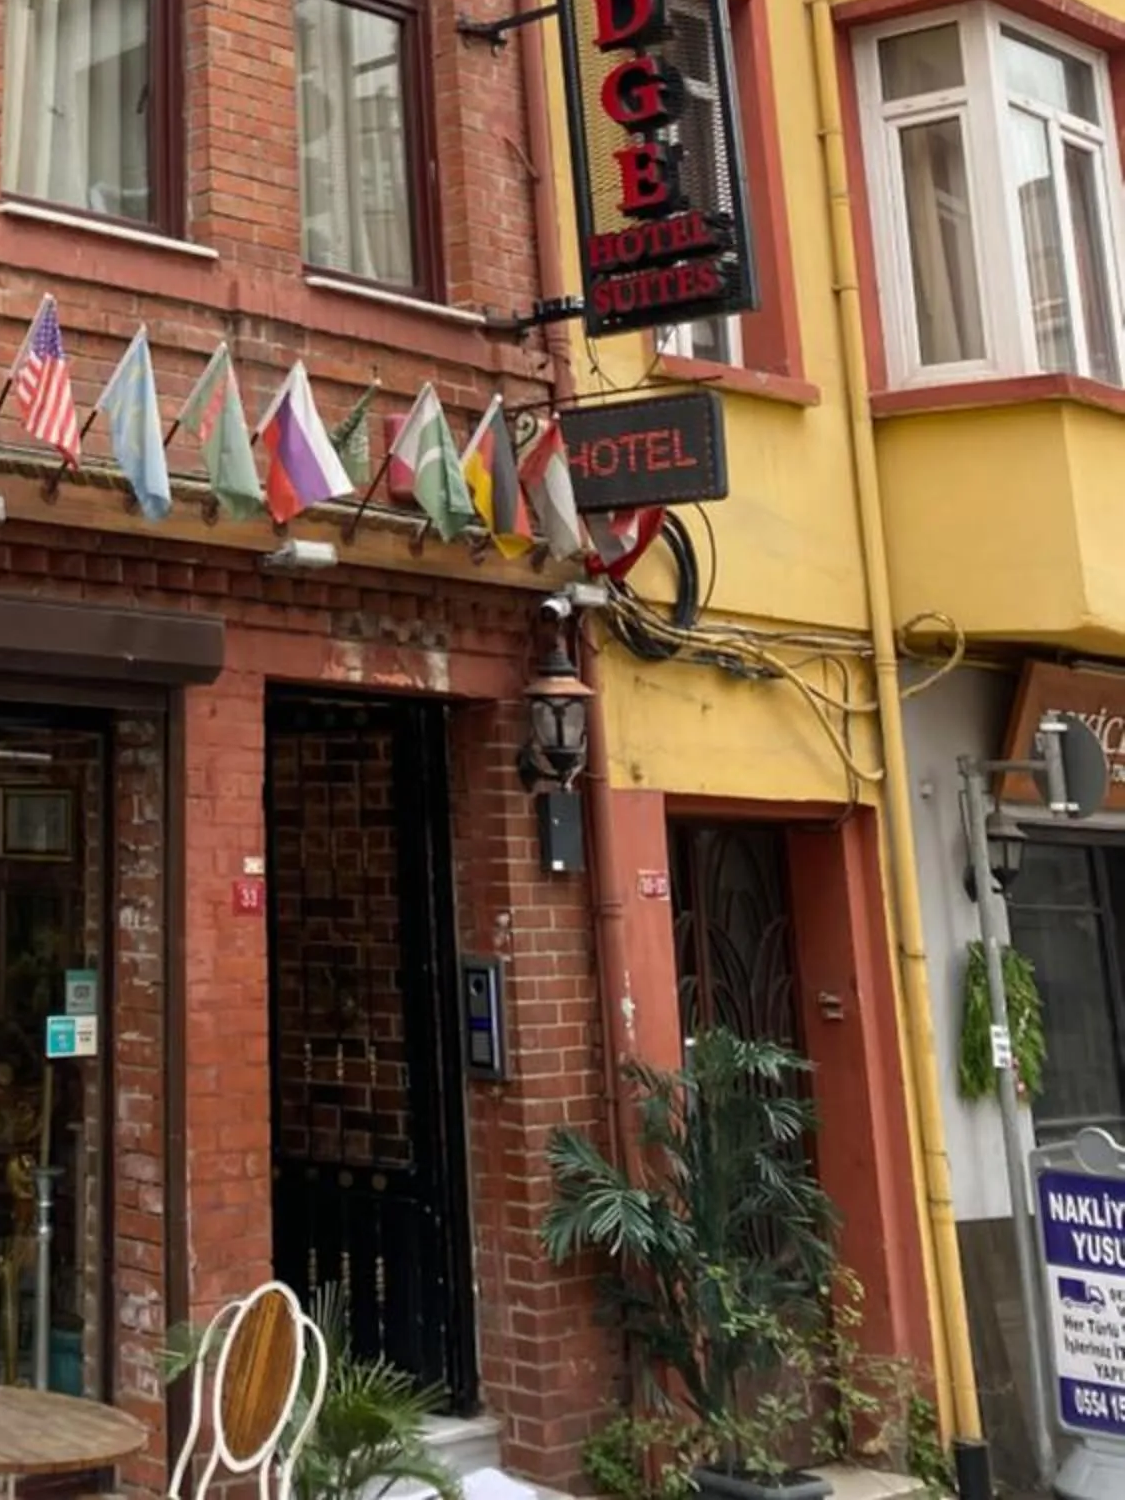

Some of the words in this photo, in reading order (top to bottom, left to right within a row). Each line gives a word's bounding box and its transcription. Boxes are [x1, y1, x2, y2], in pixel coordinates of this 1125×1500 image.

[587, 208, 713, 267] HOTEL
[592, 258, 721, 316] SUITES
[1049, 1191, 1125, 1230] NAKLİY
